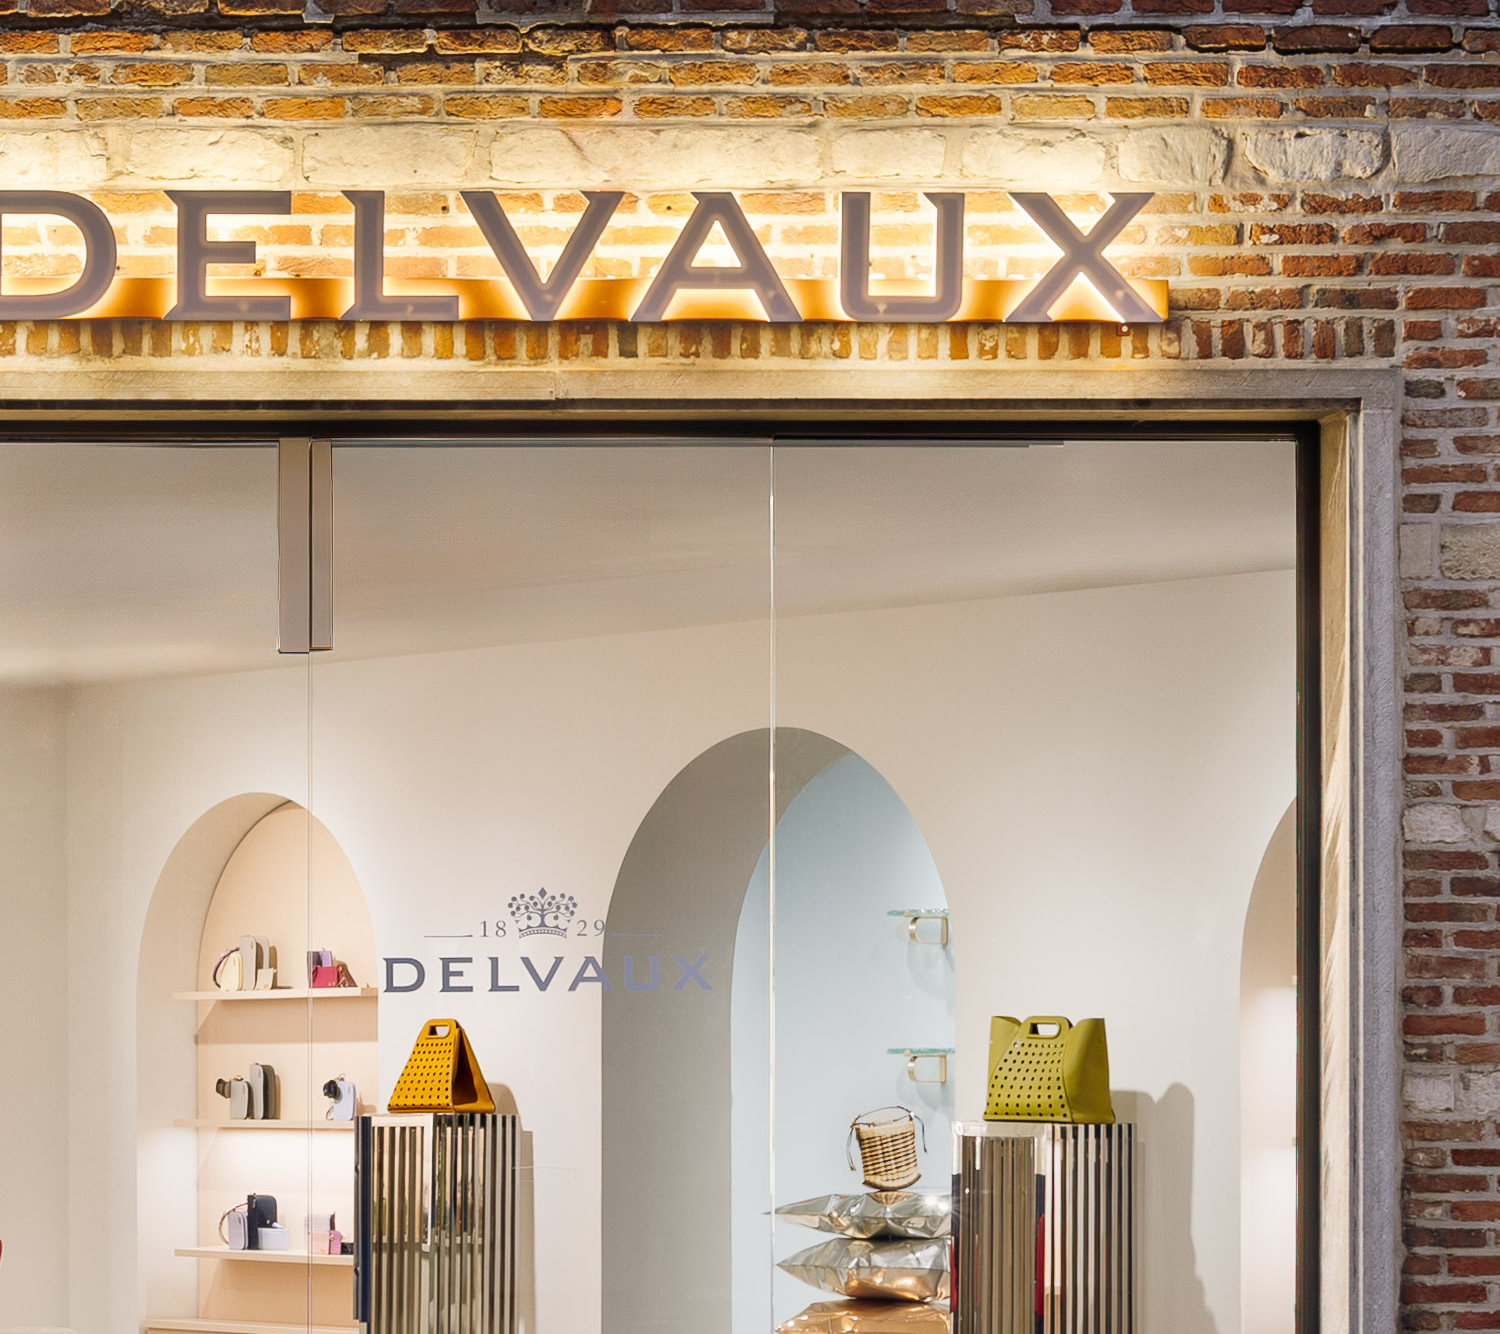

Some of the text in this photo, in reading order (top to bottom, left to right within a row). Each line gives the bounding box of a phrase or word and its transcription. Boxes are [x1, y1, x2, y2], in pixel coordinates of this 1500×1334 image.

[480, 919, 605, 938] 18 29
[382, 955, 714, 993] DELVAUX
